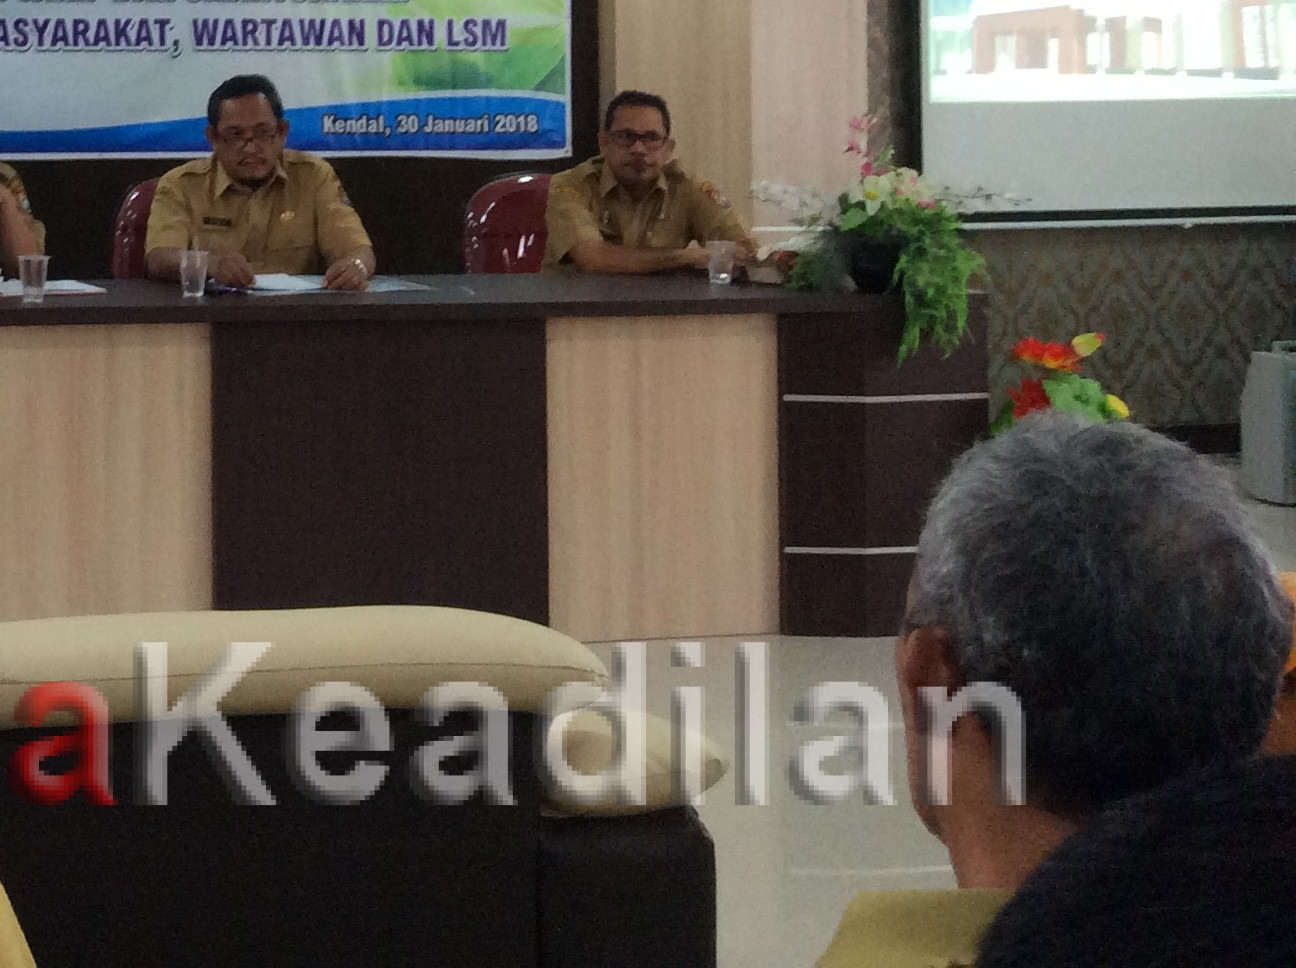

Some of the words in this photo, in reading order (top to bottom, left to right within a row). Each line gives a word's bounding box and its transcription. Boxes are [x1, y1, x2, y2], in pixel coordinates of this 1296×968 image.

[191, 17, 368, 50] WARTAWAN
[376, 17, 438, 50] DAN
[445, 17, 508, 51] LSM
[322, 113, 392, 136] Kendal,
[396, 113, 419, 134] 30
[423, 113, 490, 134] Januari
[494, 113, 540, 134] 2018
